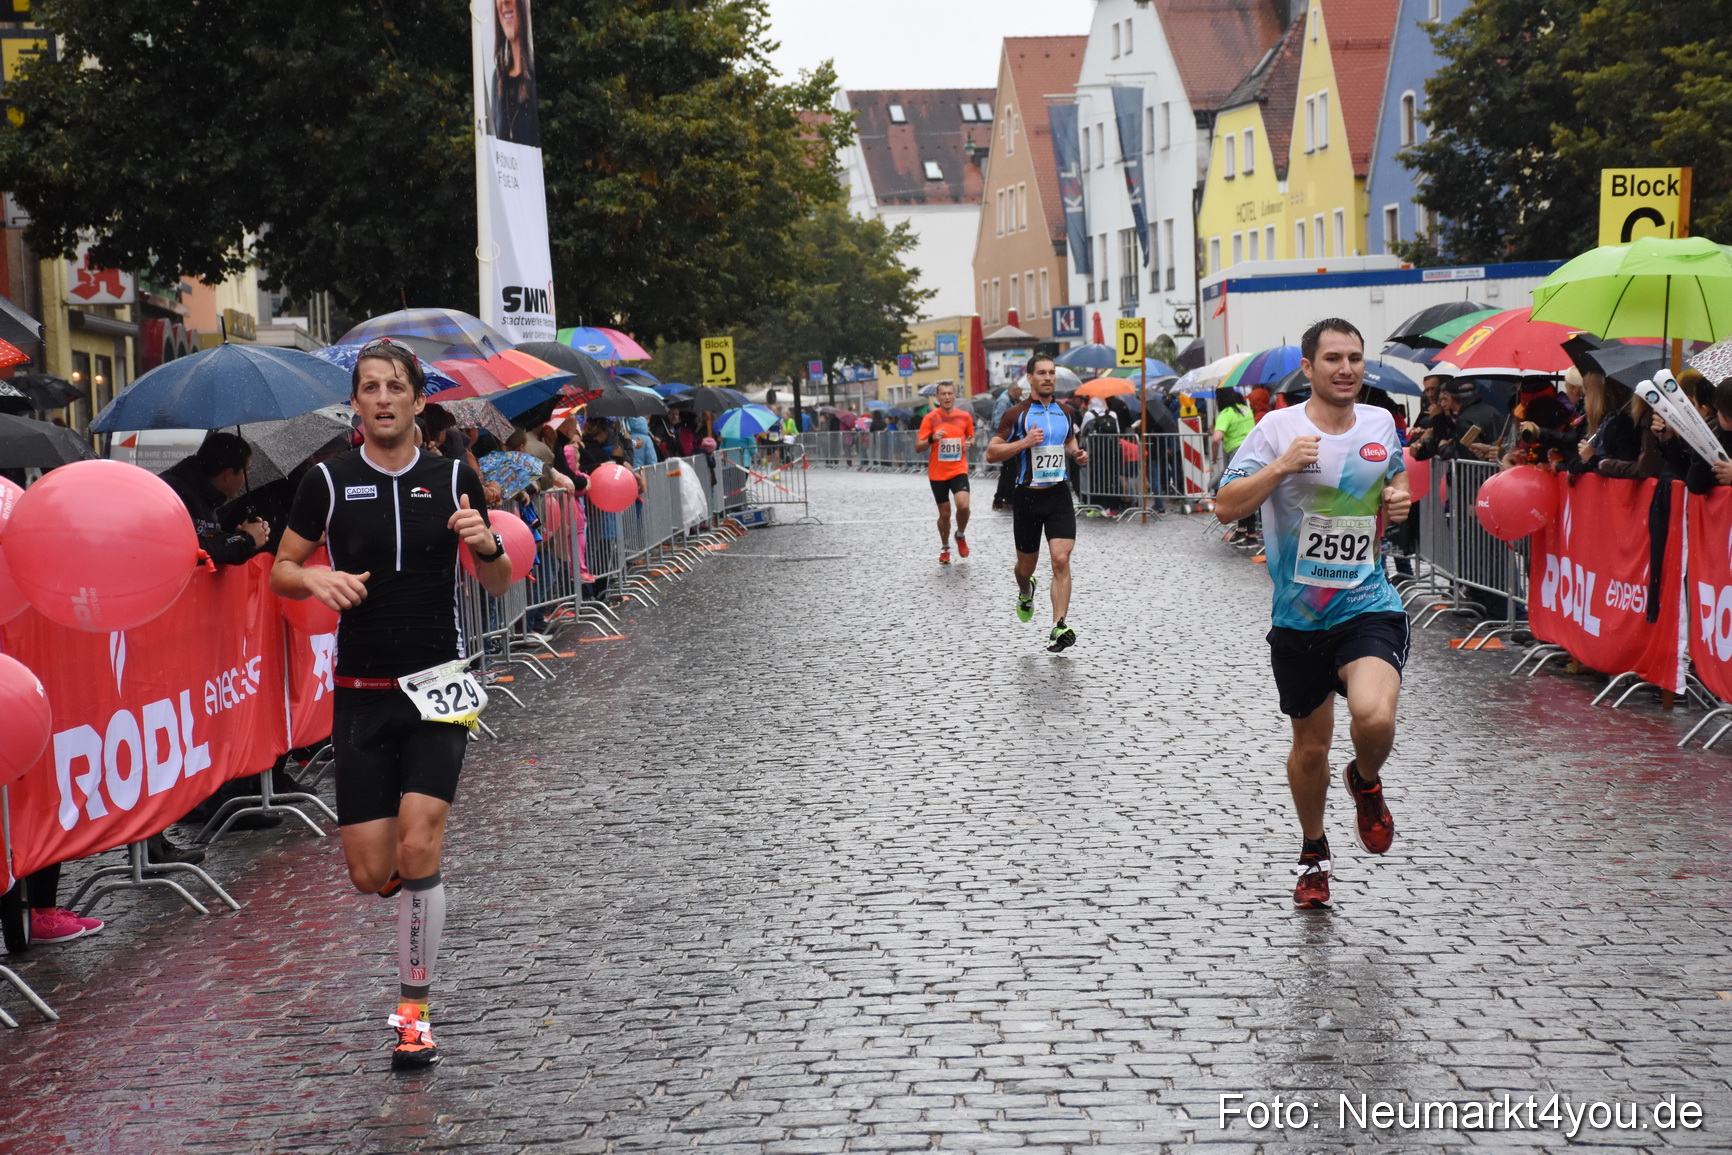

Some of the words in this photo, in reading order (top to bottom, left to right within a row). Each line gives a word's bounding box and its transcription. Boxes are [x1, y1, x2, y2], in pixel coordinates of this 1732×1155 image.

[1612, 173, 1680, 197] Block
[1236, 201, 1257, 224] HOTEL
[1620, 207, 1666, 244] C
[502, 286, 549, 315] swn
[1119, 320, 1143, 329] Block
[704, 340, 730, 349] Block
[1124, 333, 1138, 355] D
[711, 352, 727, 375] D
[941, 444, 960, 453] 2019
[1036, 454, 1064, 468] 2727
[1306, 532, 1371, 561] 2592
[1311, 565, 1359, 580] Johannes
[1605, 578, 1649, 614] energi
[427, 679, 480, 715] 329
